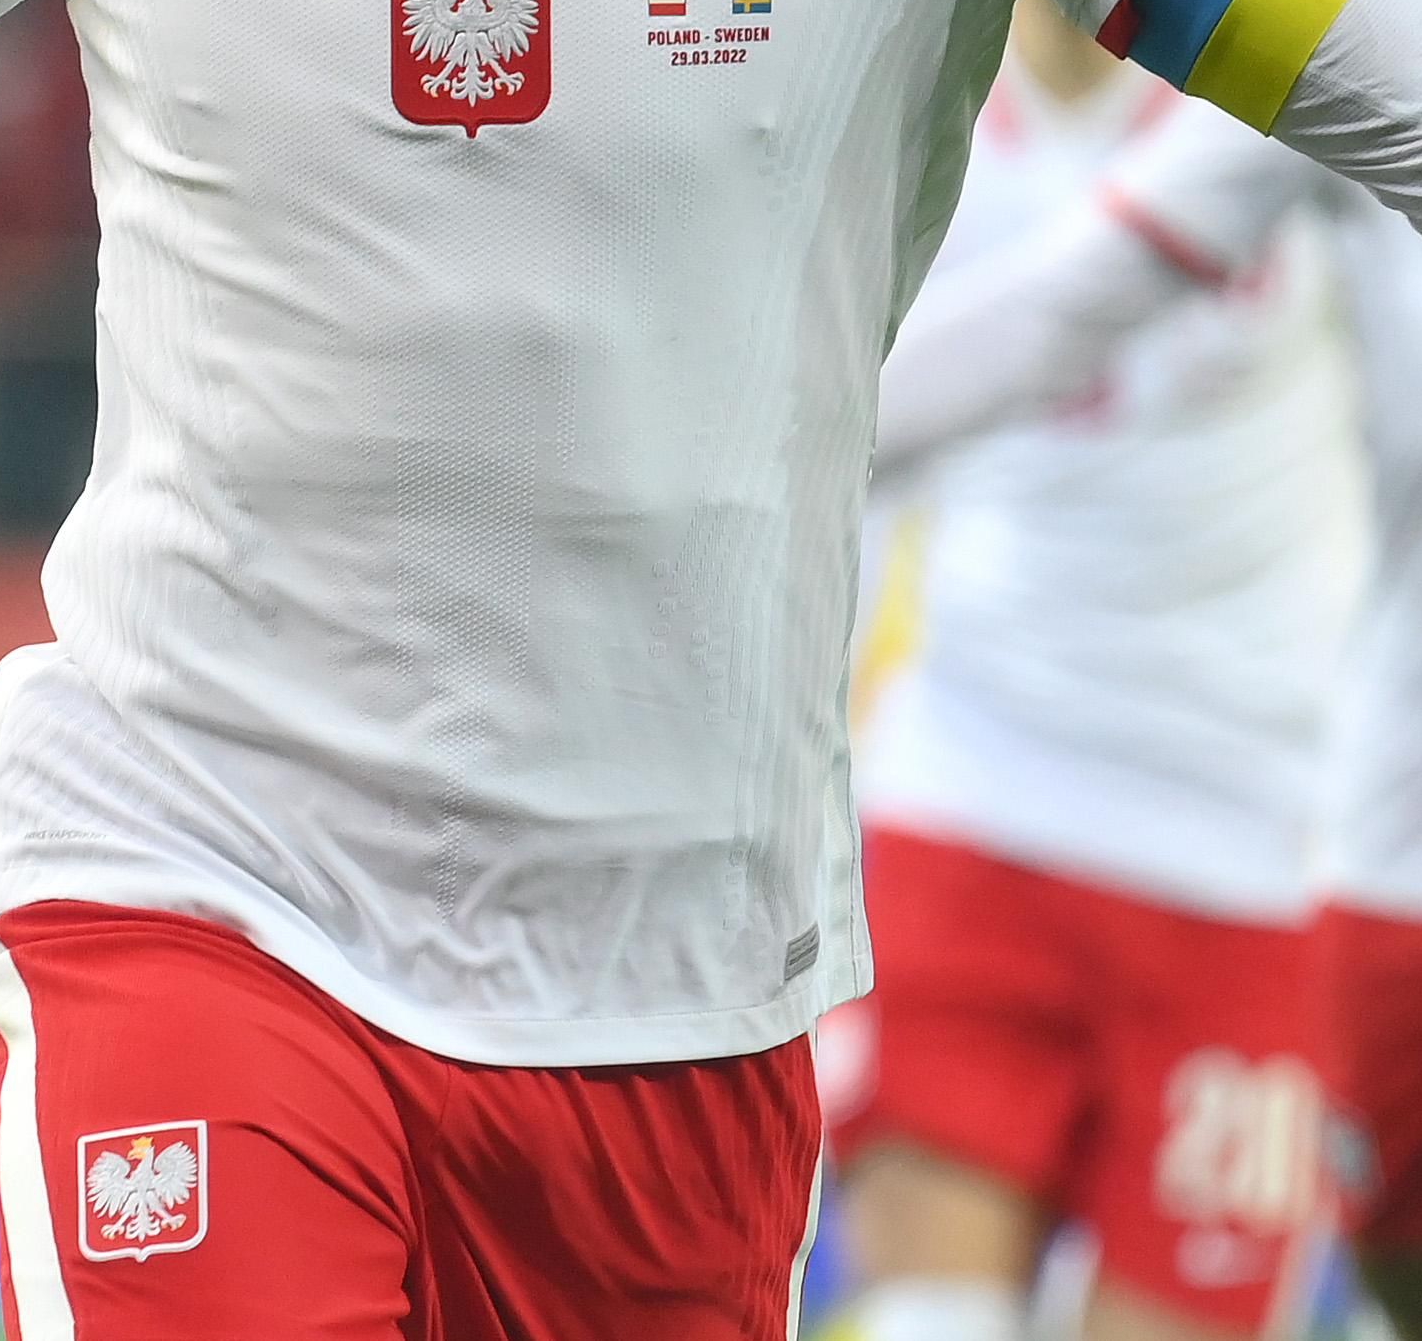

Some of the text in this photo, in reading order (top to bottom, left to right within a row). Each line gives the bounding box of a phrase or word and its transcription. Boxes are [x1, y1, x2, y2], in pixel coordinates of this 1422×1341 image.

[647, 30, 701, 46] POLAND
[714, 26, 770, 43] SWEDEN
[671, 48, 747, 66] 29.03.2022
